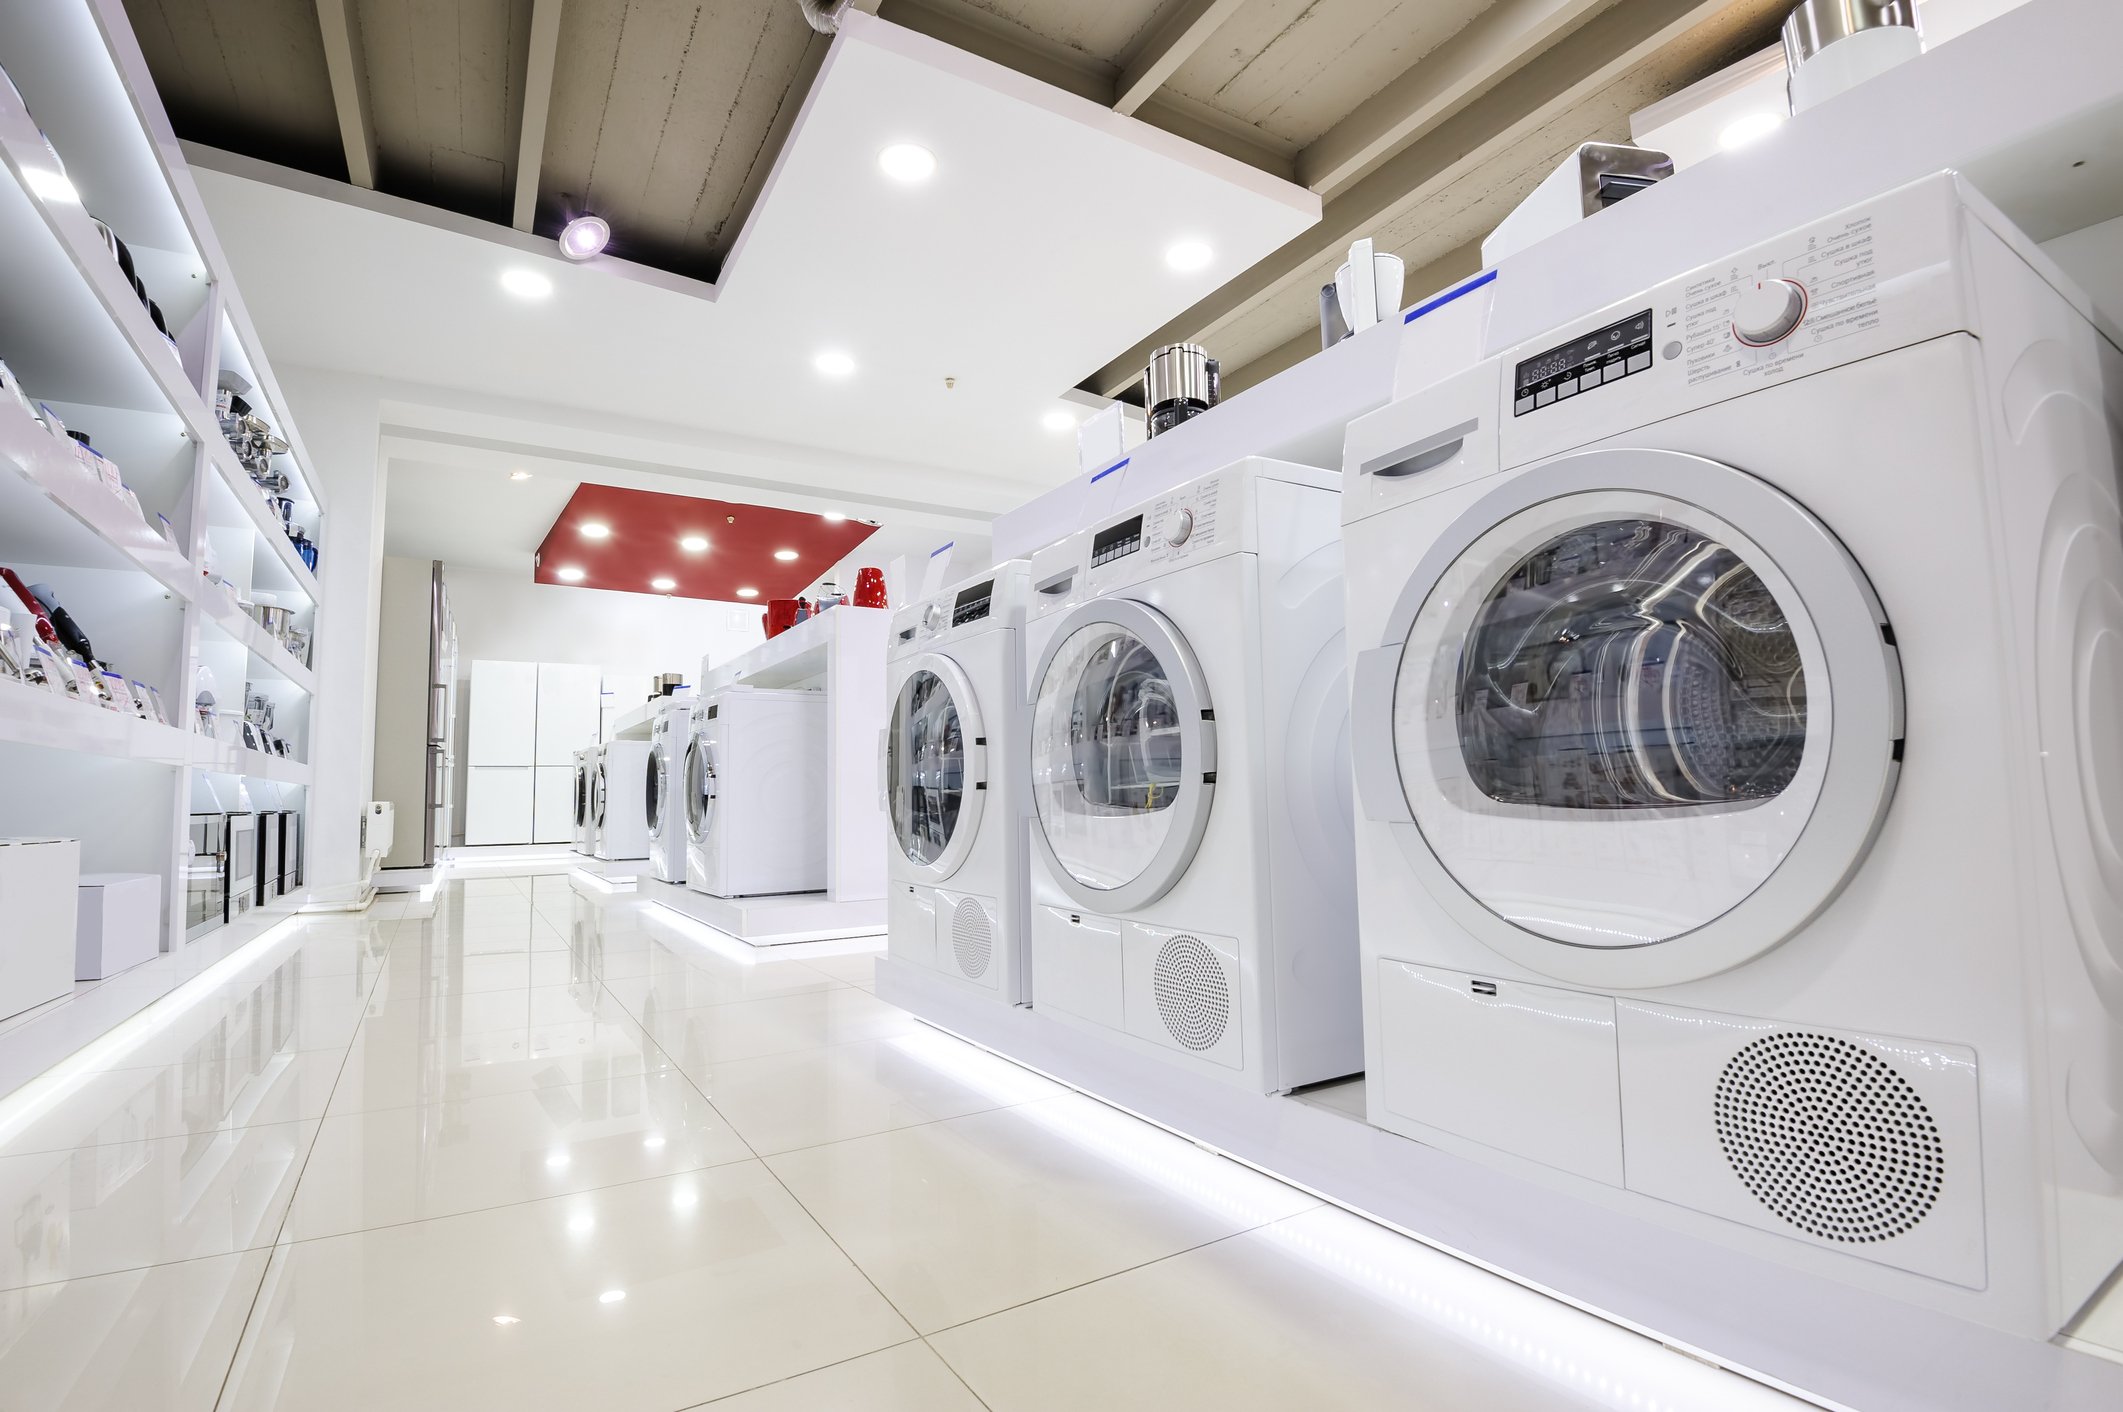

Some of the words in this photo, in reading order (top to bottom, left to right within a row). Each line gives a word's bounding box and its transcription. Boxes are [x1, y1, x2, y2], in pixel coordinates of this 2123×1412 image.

[1820, 246, 1844, 258] Сушка
[1851, 236, 1872, 247] шкаф
[1834, 255, 1858, 266] Сушка
[1859, 248, 1873, 257] под
[1685, 277, 1716, 292] Синтетика
[1685, 299, 1705, 310] Сушка
[1710, 290, 1728, 300] шкаф
[1685, 311, 1705, 322] Сушка
[1705, 306, 1718, 314] под
[1810, 324, 1834, 335] Сушка
[1846, 310, 1879, 325] времени
[1858, 318, 1880, 329] тепло
[1688, 364, 1711, 376] Шерсть
[1743, 365, 1764, 377] Сушка
[1774, 352, 1805, 367] времени
[1764, 366, 1784, 377] холод
